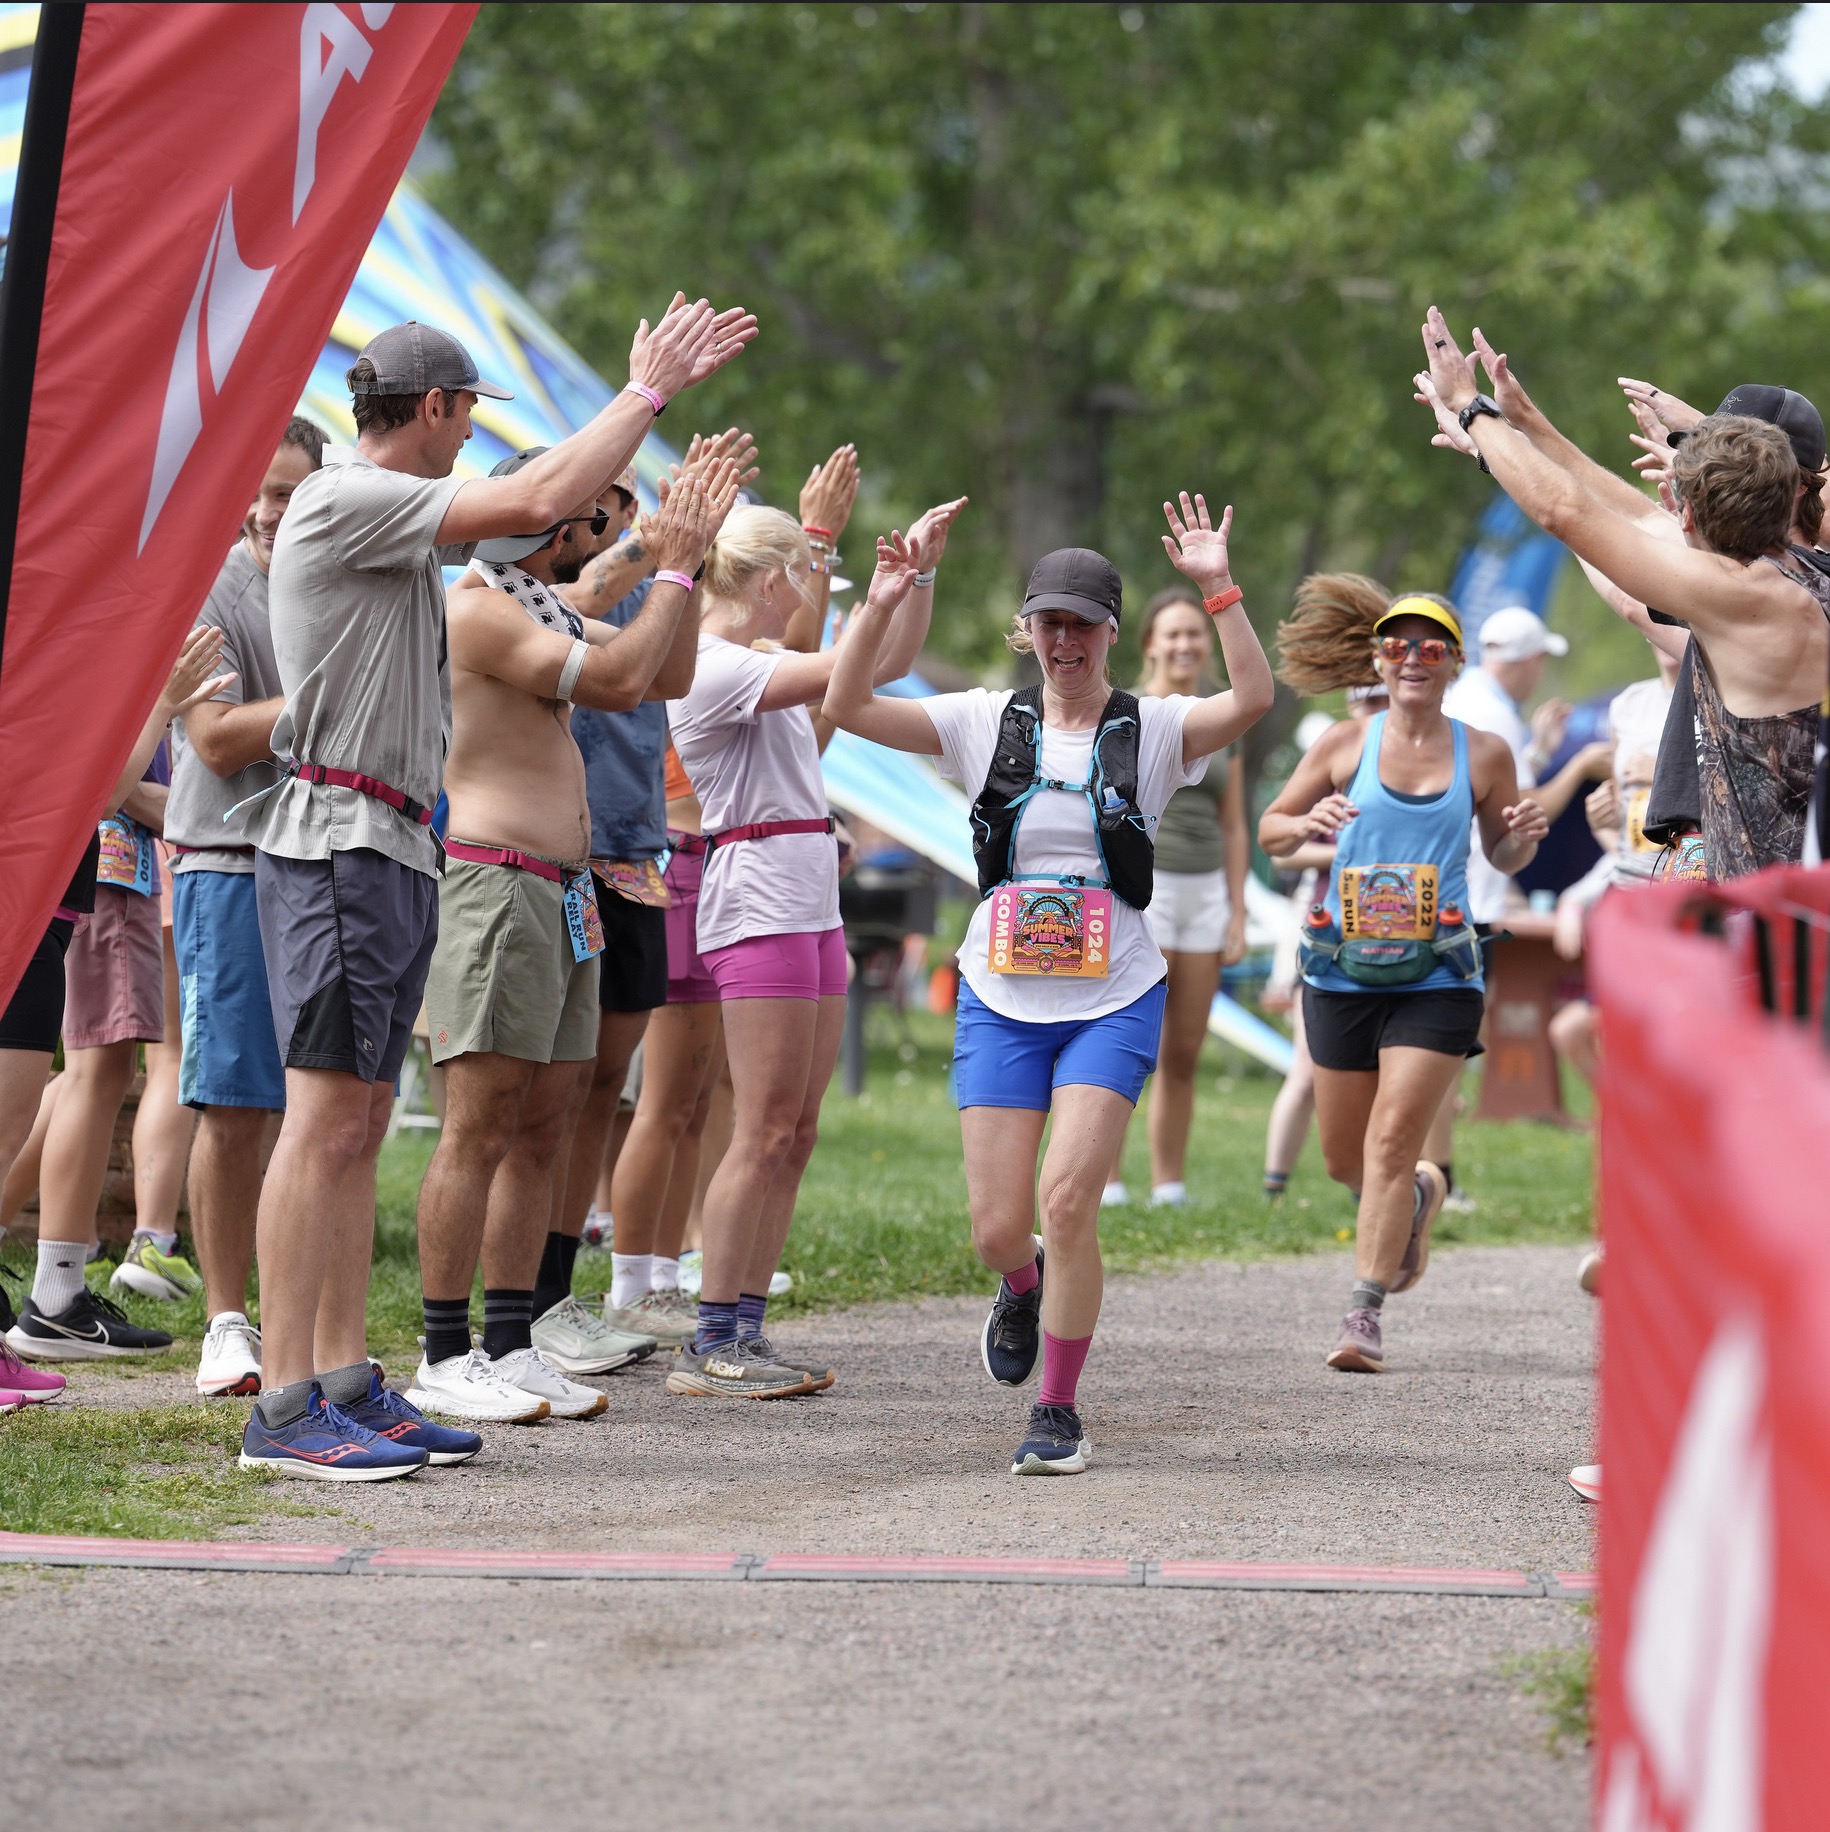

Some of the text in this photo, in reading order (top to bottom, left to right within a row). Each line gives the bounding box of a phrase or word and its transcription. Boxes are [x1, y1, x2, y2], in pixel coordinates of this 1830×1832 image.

[1343, 899, 1355, 933] RUN
[1421, 879, 1434, 927] 2022
[567, 902, 580, 939] RELAY
[576, 923, 586, 951] RUN
[994, 893, 1011, 967] COMBO
[1022, 923, 1075, 938] SUMMER
[1087, 907, 1105, 963] 1024
[1030, 932, 1066, 944] VIBES
[704, 1358, 746, 1379] HOKA
